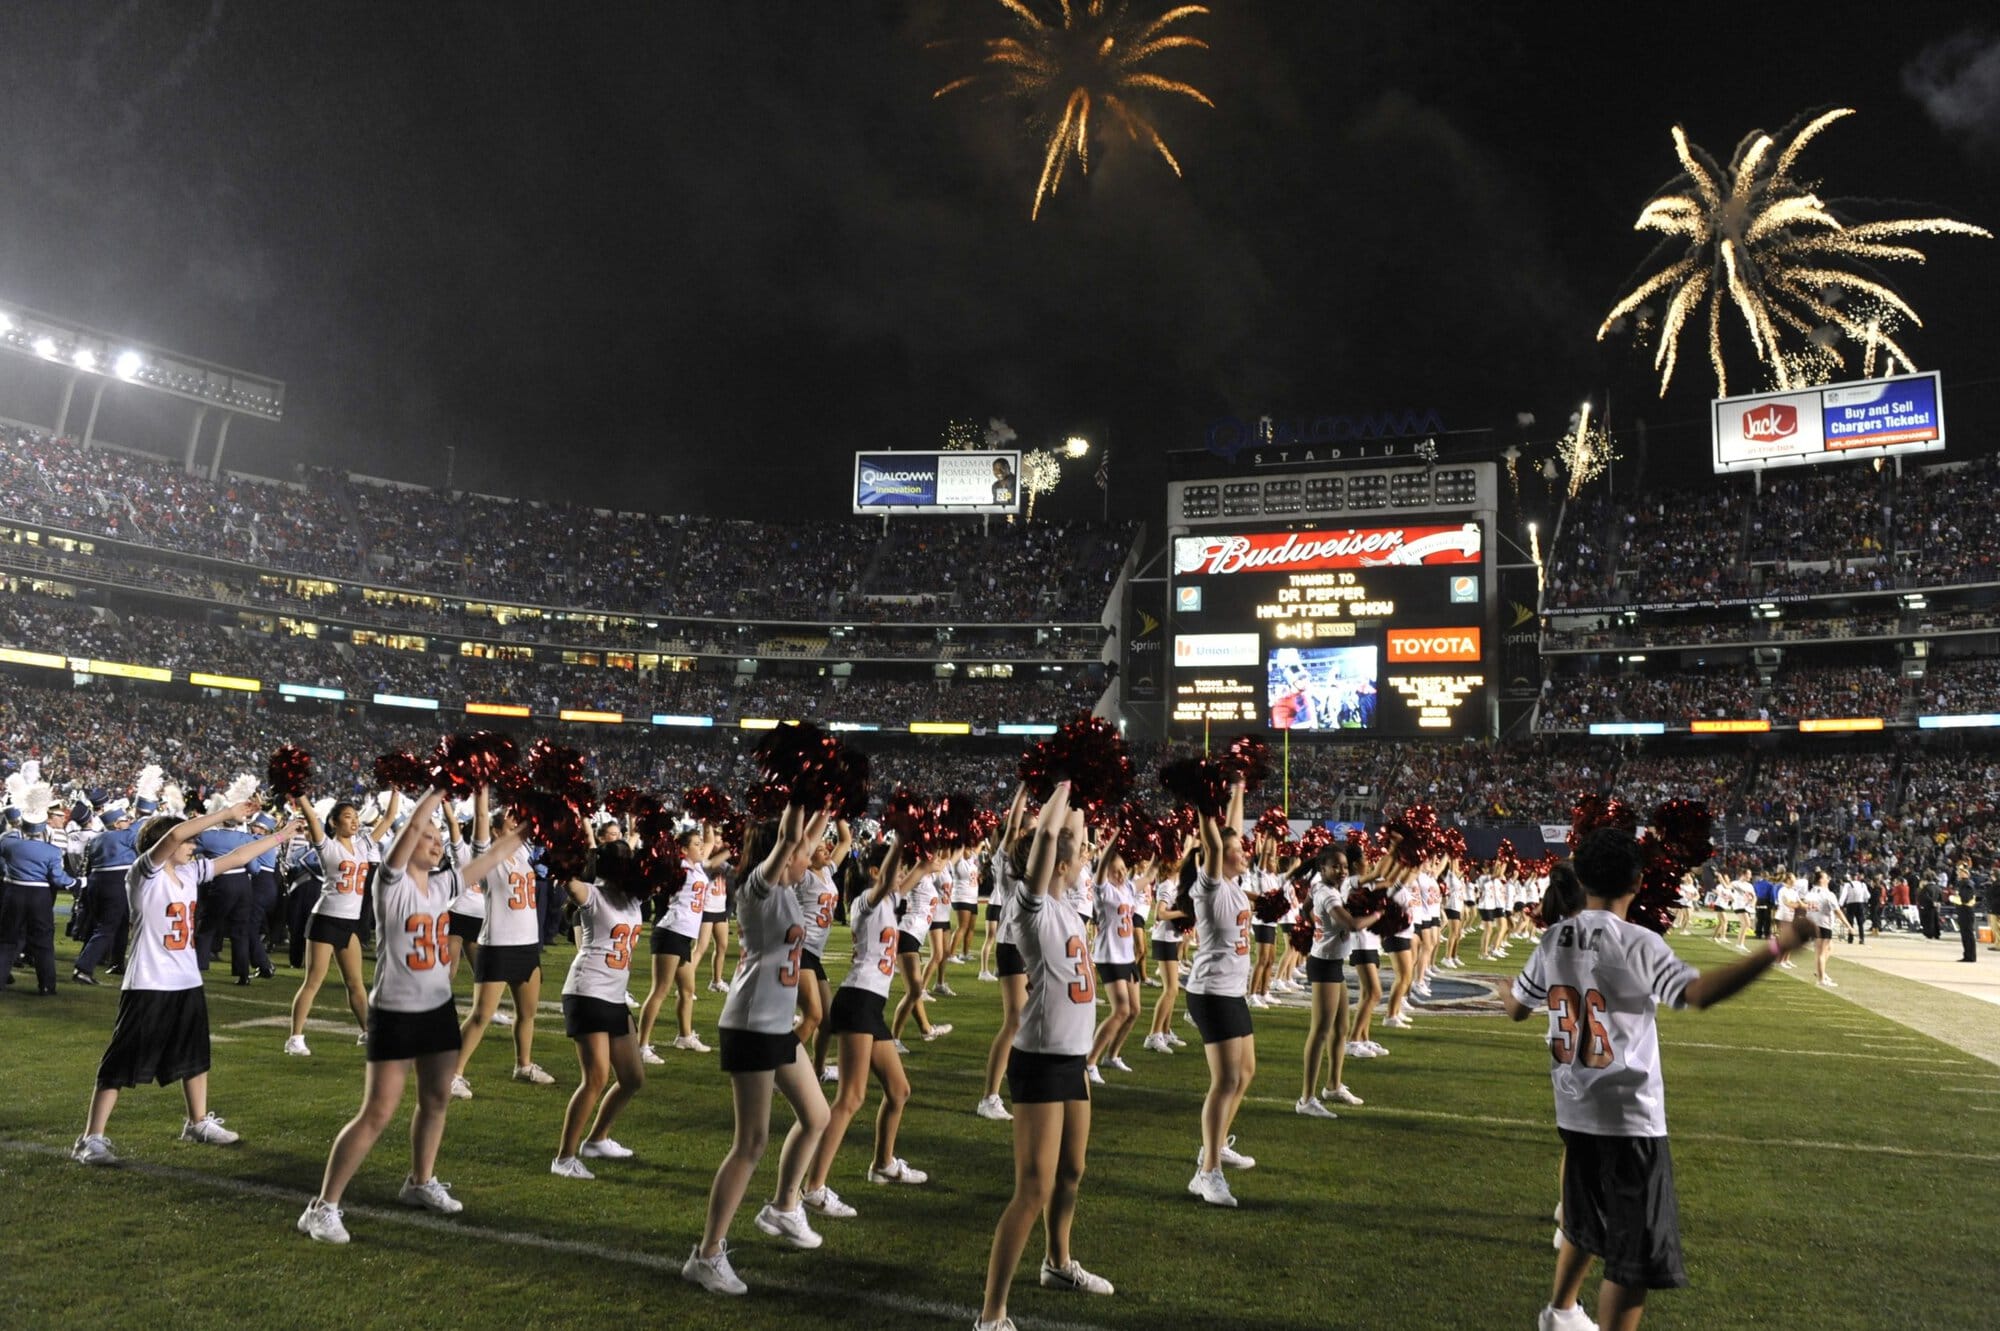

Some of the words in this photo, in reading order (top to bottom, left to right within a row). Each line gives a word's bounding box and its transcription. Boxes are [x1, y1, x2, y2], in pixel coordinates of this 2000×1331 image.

[1845, 408, 1865, 419] Buy
[1869, 404, 1889, 416] and
[1892, 401, 1913, 414] Sell
[1744, 407, 1796, 439] Jack
[1831, 419, 1882, 433] Chargers
[1885, 412, 1929, 428] Tickets!
[1255, 442, 1427, 465] STADIUM
[942, 459, 991, 468] PALOMAR
[863, 470, 934, 486] QUALCOMM
[942, 468, 991, 477] POMERADO
[941, 477, 991, 485] HEALTH
[876, 485, 922, 494] Innovation
[1203, 529, 1404, 574] Budweiser
[1289, 574, 1335, 586] THANKS
[1338, 573, 1356, 585] TO
[1278, 588, 1300, 602] DR
[1306, 586, 1366, 601] PEPPER
[1256, 602, 1340, 618] HALFTIME
[1349, 600, 1394, 616] SHOW
[1130, 640, 1160, 653] Sprint
[1391, 637, 1476, 655] TOYOTA
[1502, 631, 1538, 646] Sprint
[1548, 984, 1614, 1069] 36
